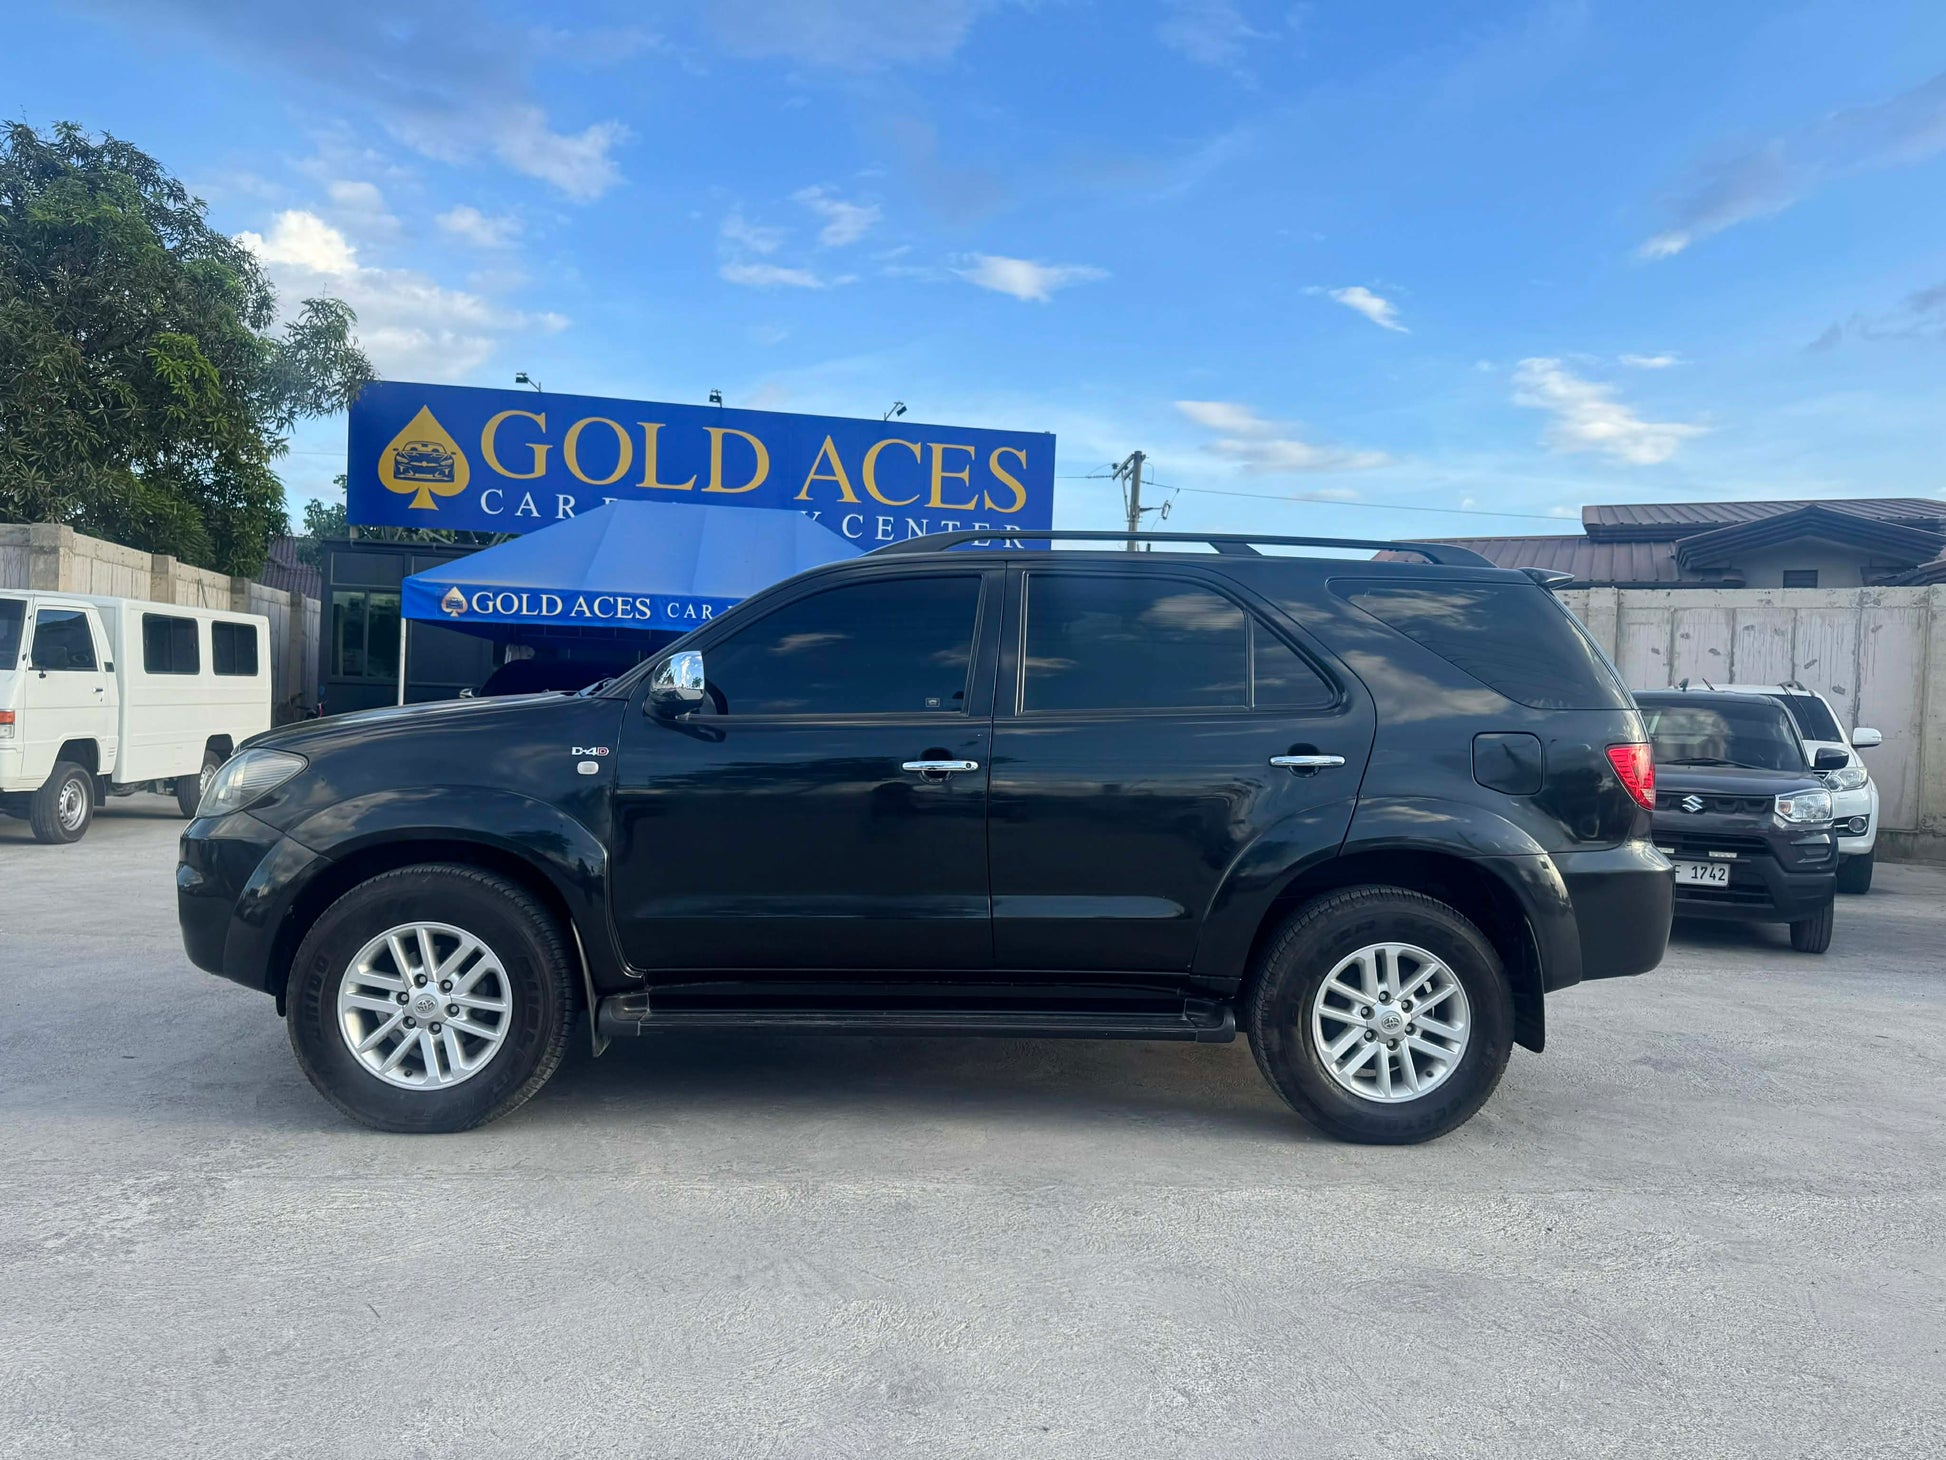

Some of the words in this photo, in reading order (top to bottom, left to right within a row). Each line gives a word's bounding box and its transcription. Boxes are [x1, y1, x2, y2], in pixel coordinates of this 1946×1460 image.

[481, 409, 770, 494] GOLD
[793, 434, 1028, 514] ACES
[480, 488, 576, 519] CAR
[471, 591, 563, 616] GOLD
[569, 595, 652, 620] ACES
[667, 602, 713, 620] CAR
[1690, 865, 1726, 881] 1742
